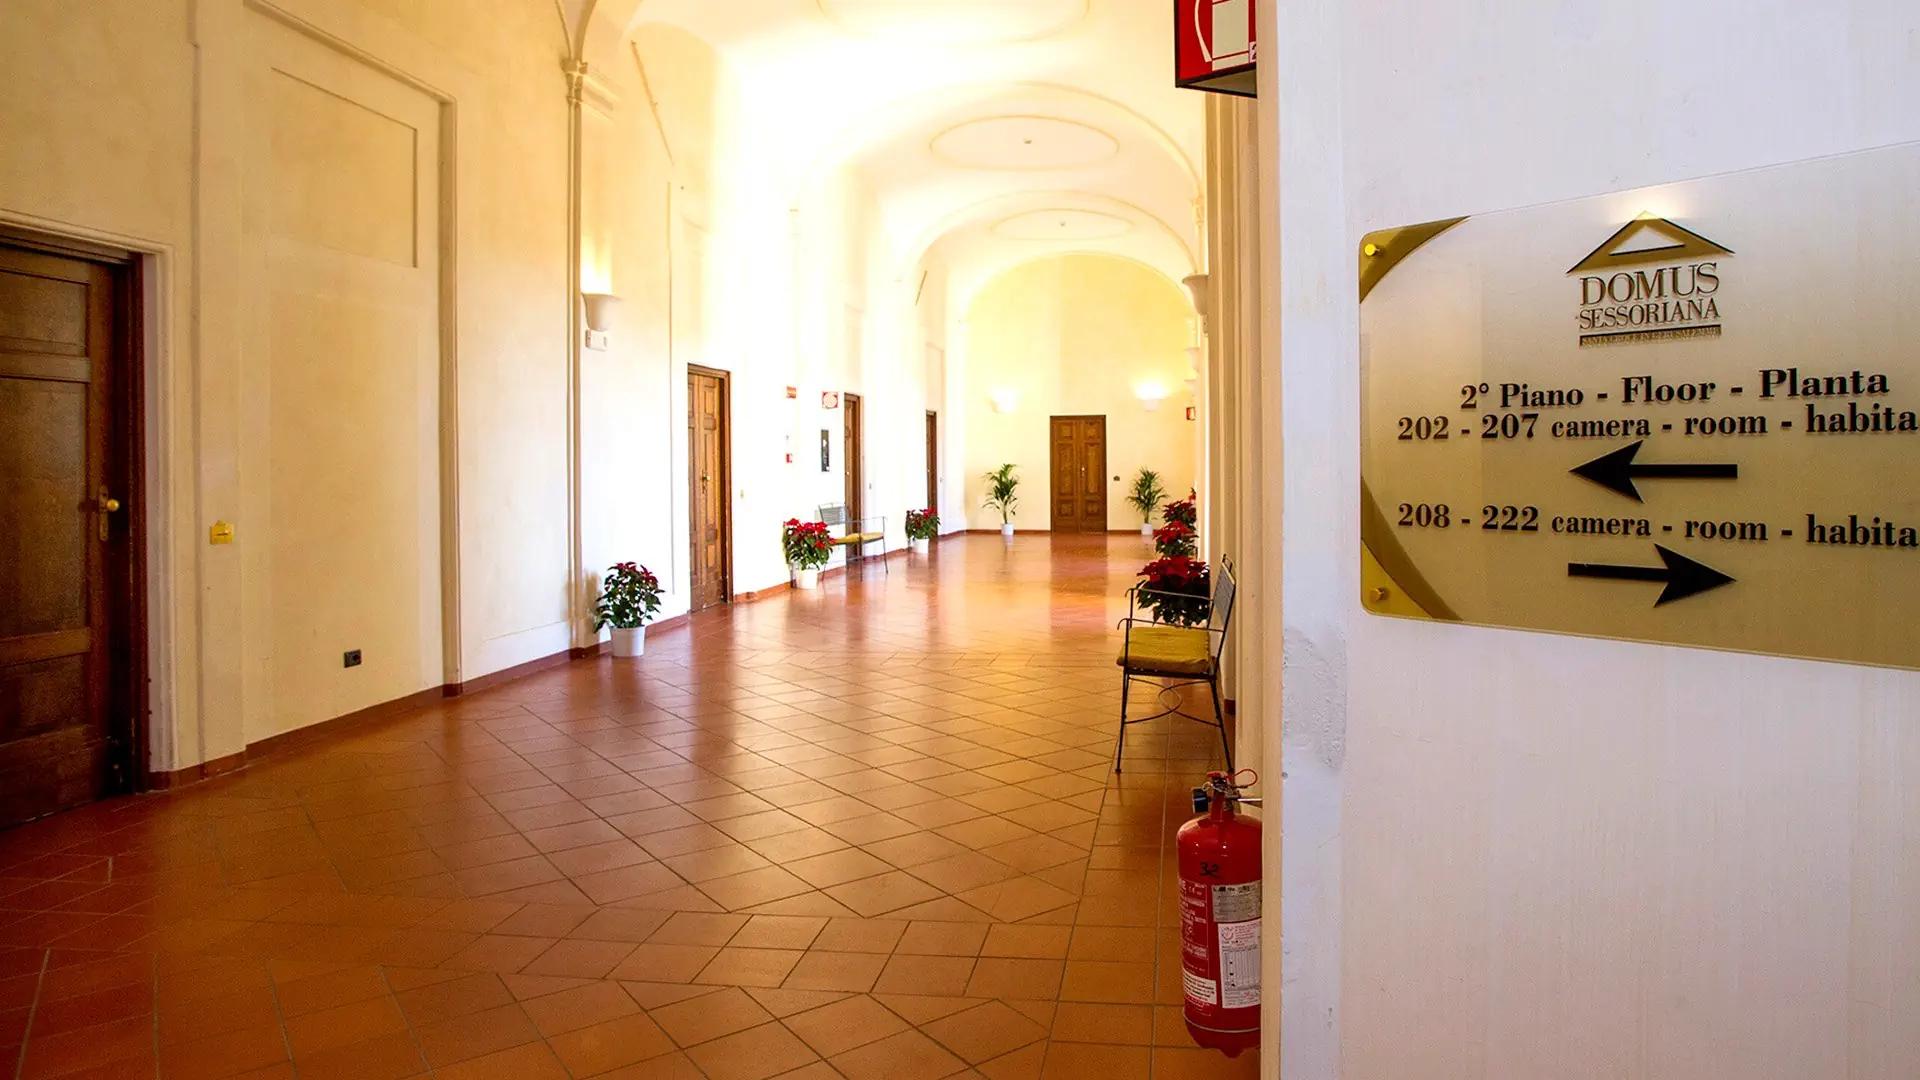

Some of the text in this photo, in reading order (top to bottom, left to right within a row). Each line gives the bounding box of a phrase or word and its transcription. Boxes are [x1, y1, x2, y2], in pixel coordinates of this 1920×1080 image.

[1579, 262, 1720, 306] DOMUS
[1579, 297, 1721, 330] SESSORIANA
[1499, 383, 1584, 408] Piano
[1621, 375, 1716, 404] Floor
[1759, 367, 1890, 398] Planta
[1397, 415, 1450, 441] 202
[1481, 413, 1539, 439] 207
[1551, 418, 1652, 438] camera
[1684, 415, 1768, 436] room
[1805, 402, 1919, 435] habita
[1397, 502, 1451, 529] 208
[1481, 505, 1539, 533] 222
[1551, 516, 1652, 537] camera
[1684, 520, 1769, 542] room
[1805, 513, 1920, 551] habita
